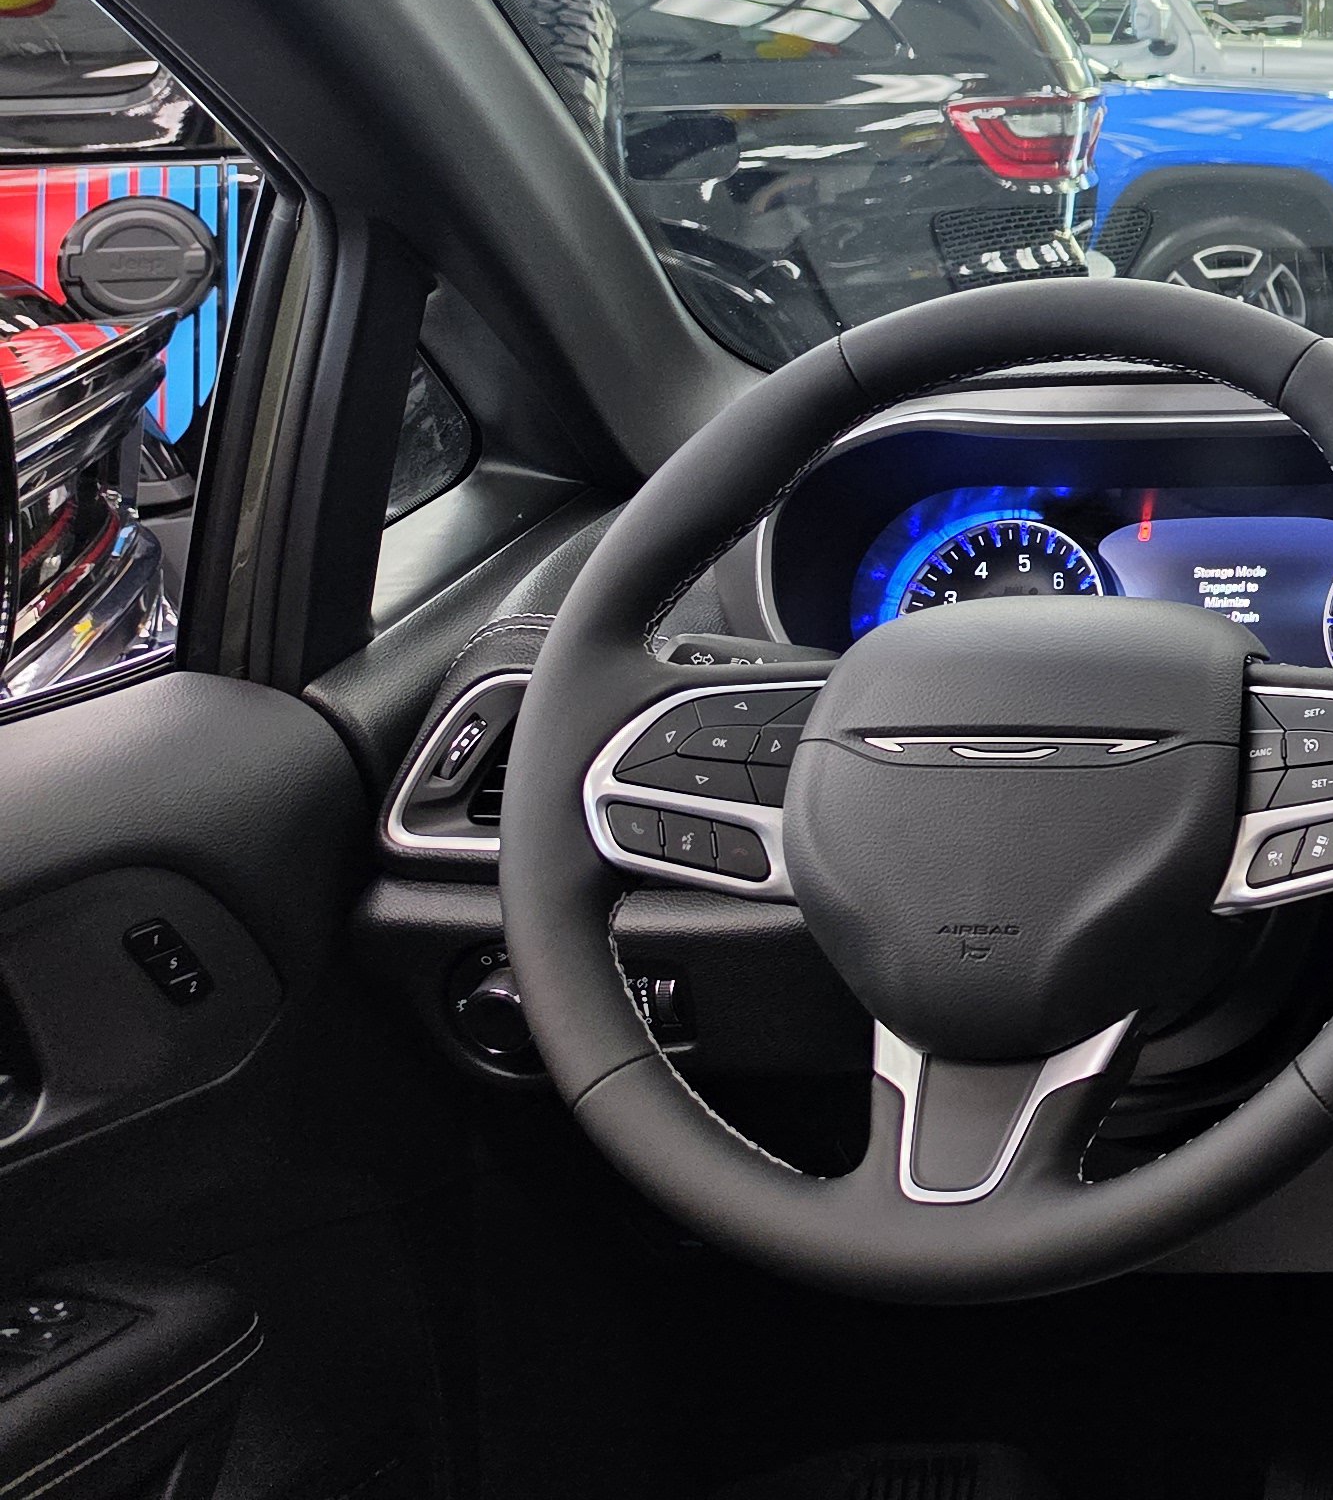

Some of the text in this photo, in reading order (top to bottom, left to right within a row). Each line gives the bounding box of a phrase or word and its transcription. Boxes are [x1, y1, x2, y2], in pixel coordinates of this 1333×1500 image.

[1018, 554, 1031, 572] 5
[974, 561, 989, 579] 4
[1193, 565, 1267, 580] Storage Mode
[1053, 572, 1064, 590] 6
[1198, 581, 1259, 595] Engaged to
[1204, 596, 1250, 609] Minimize
[1230, 610, 1260, 623] Drain
[712, 737, 727, 748] OK
[1250, 747, 1273, 758] CANC
[936, 924, 1022, 936] AIRBAG
[189, 980, 198, 993] 2
